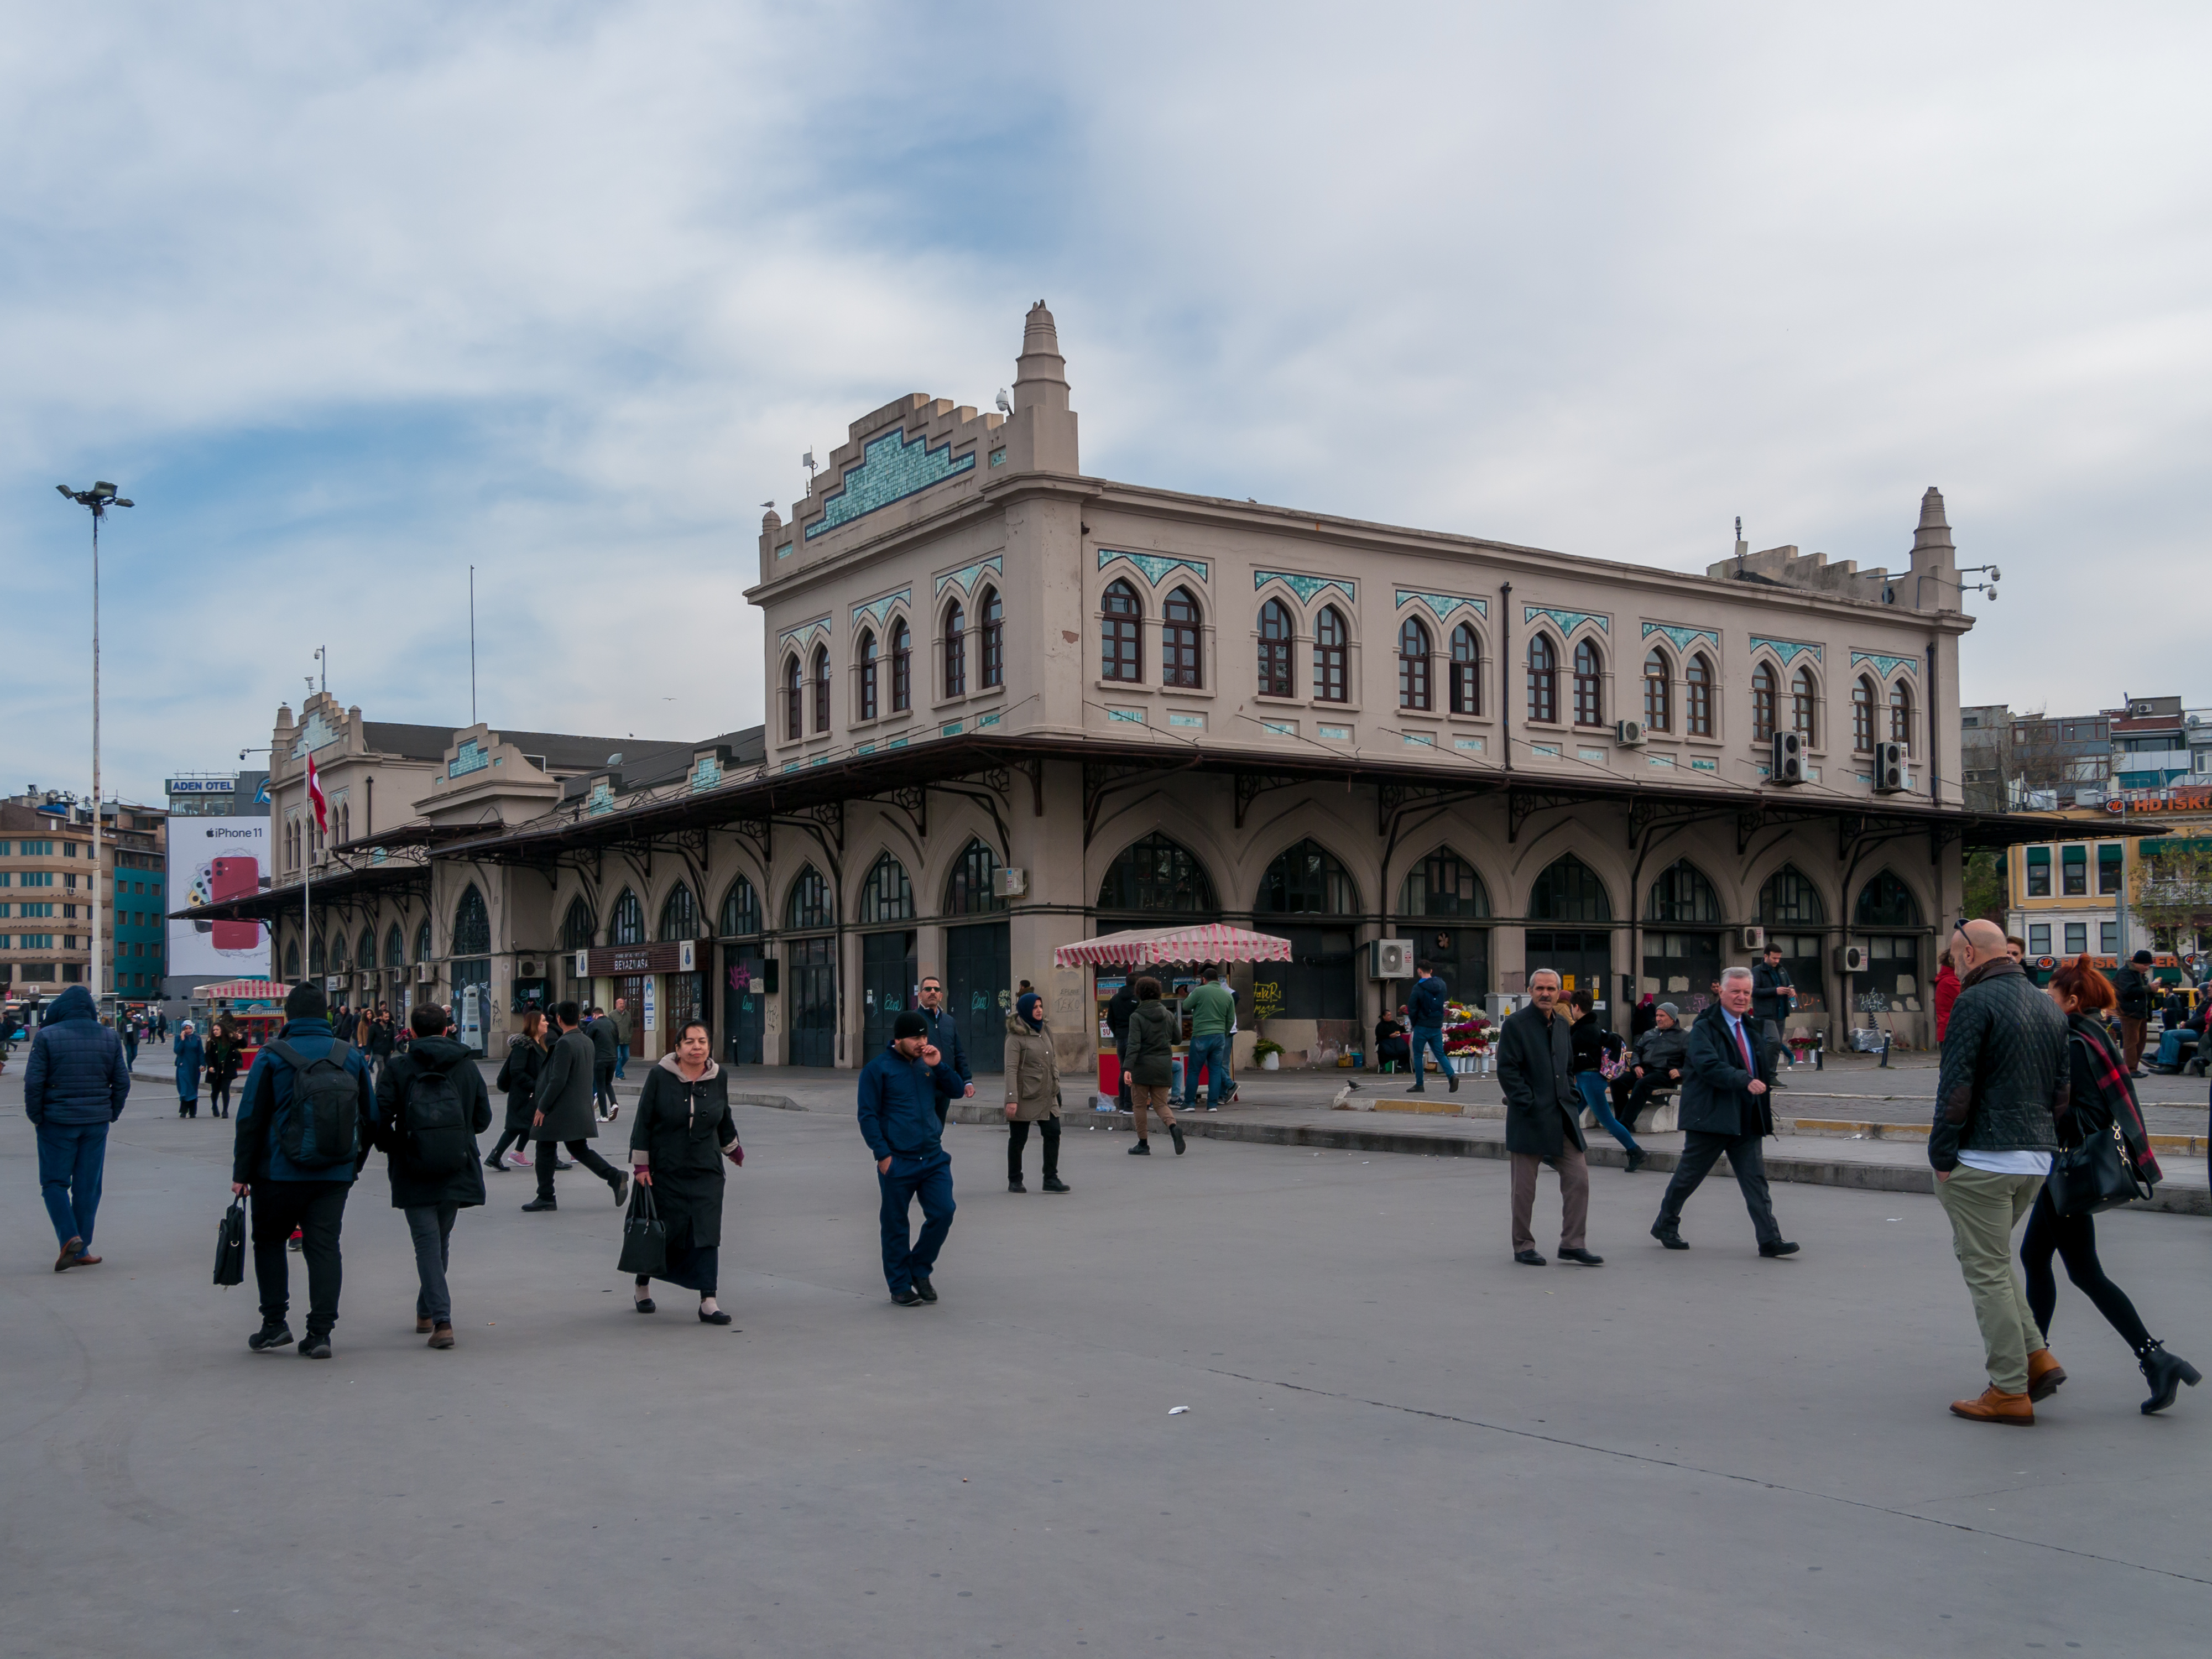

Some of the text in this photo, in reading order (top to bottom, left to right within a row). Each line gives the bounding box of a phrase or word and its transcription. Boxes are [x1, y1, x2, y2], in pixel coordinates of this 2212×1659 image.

[173, 781, 233, 791] ADEN OTEL
[2134, 797, 2163, 812] HD
[215, 828, 262, 838] iPhone 11
